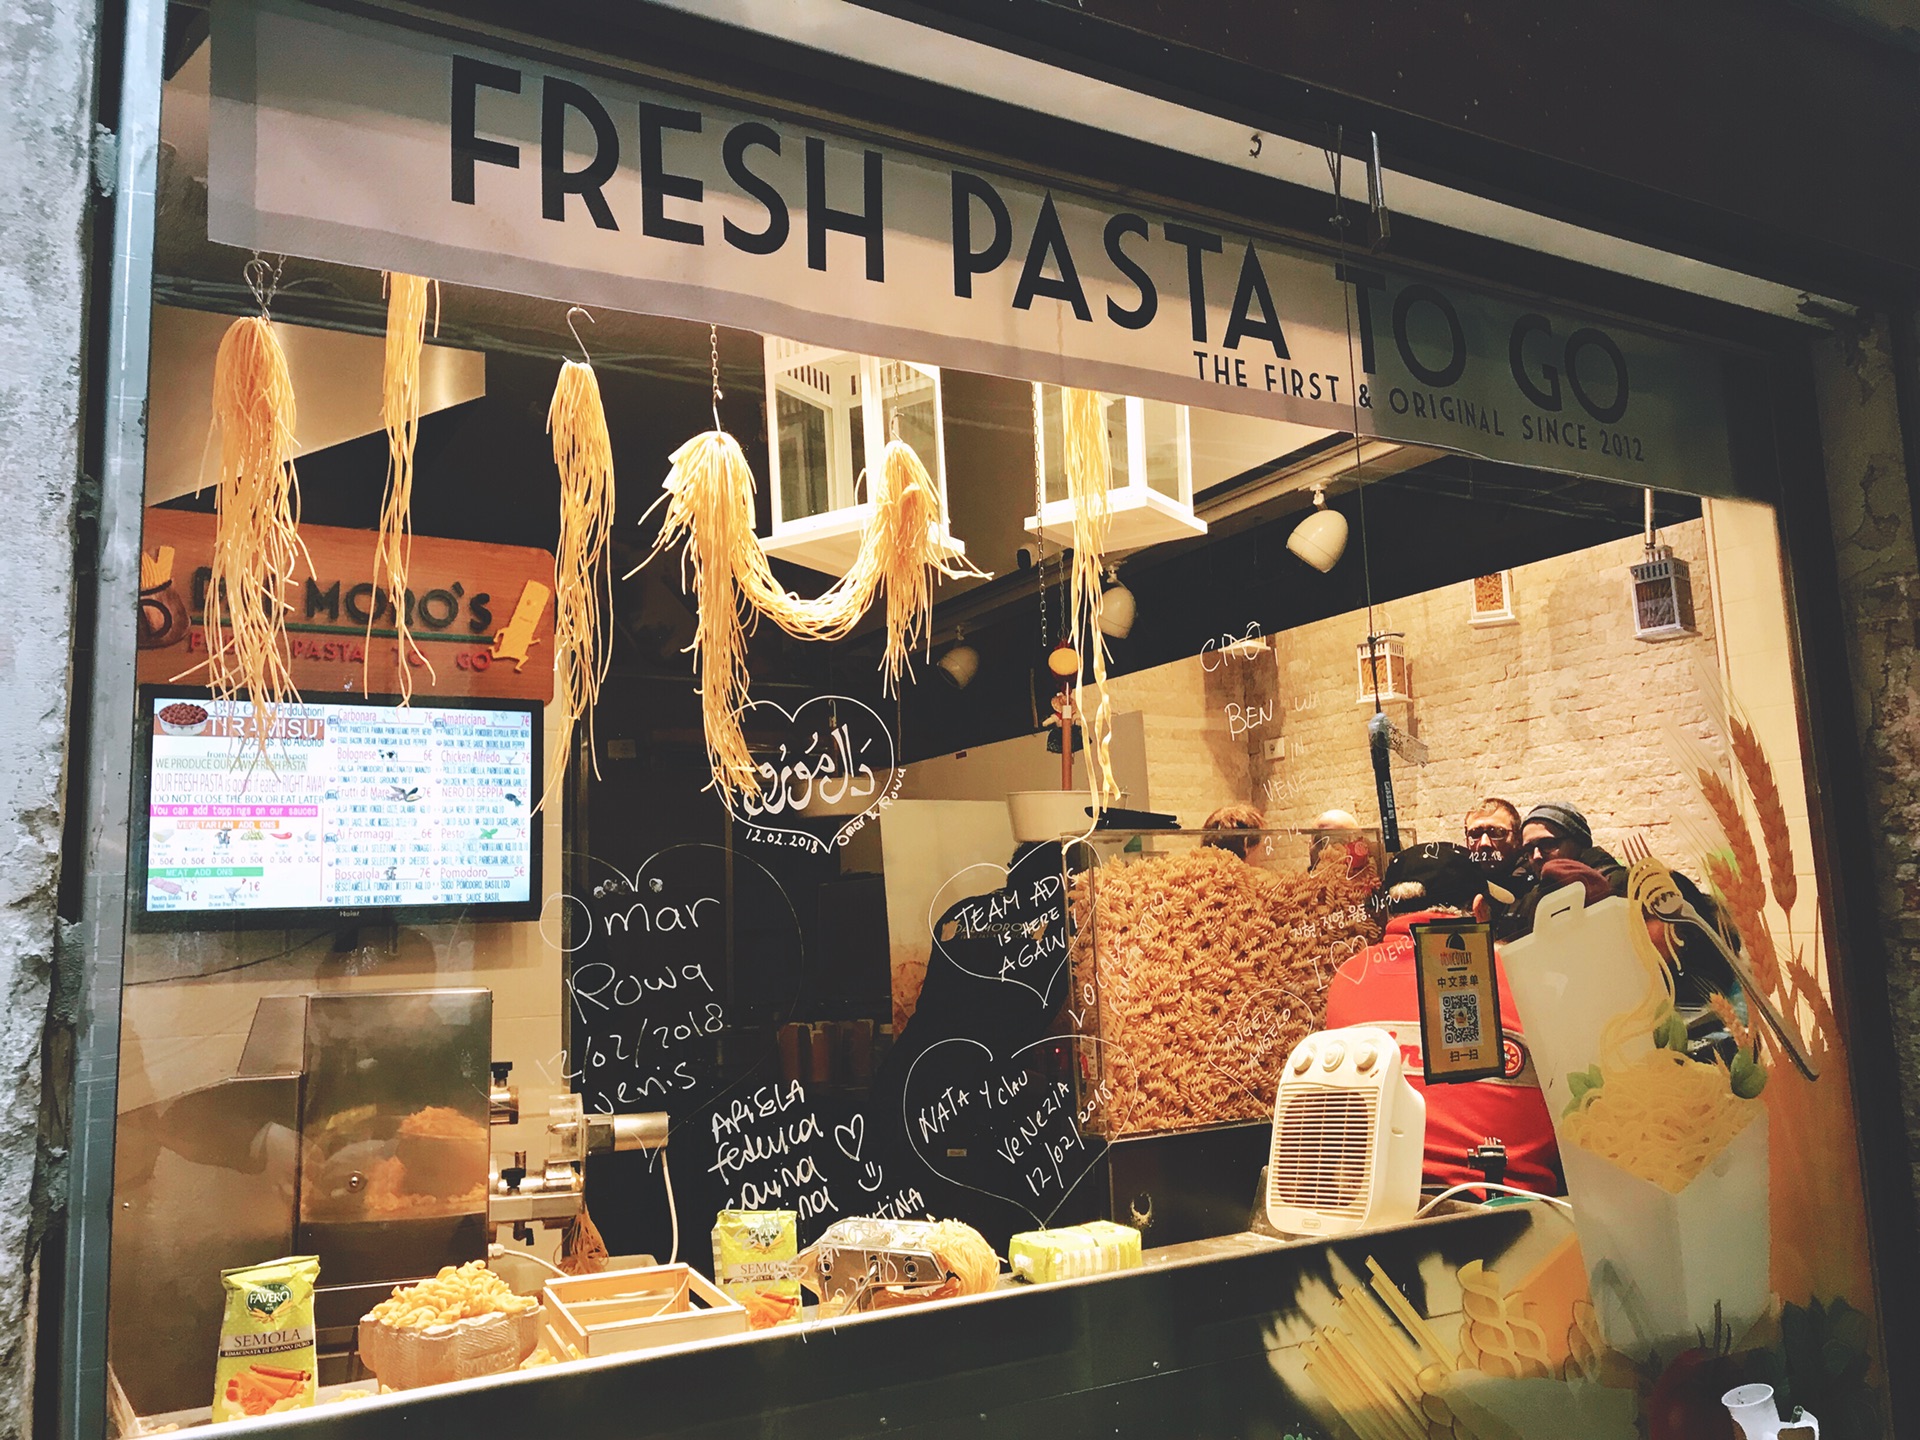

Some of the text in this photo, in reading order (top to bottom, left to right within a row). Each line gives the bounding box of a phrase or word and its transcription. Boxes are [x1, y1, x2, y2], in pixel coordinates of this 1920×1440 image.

[450, 54, 1631, 426] FRESH PASTA TO GO
[1193, 351, 1646, 463] THE FIRST & ORIGINAL SINCE 2012
[290, 638, 365, 664] PASTA
[456, 650, 491, 672] GO
[338, 708, 377, 722] Carbonara
[442, 712, 487, 725] Amatriciana
[1224, 699, 1273, 742] BEN
[337, 747, 377, 763] Bolognese
[441, 749, 471, 762] Chicken
[473, 750, 501, 763] Alfredo
[156, 758, 169, 768] WE
[171, 758, 211, 769] PRODUCE
[213, 758, 232, 769] OUR
[282, 760, 306, 770] PASTA
[156, 774, 172, 791] OUR
[174, 774, 198, 791] FRESH
[200, 774, 222, 791] PASTA
[282, 775, 304, 792] RIGHT
[307, 775, 327, 792] AWAY
[154, 794, 325, 803] DO NOT CLOSE THE BOX OR EAT LATER
[360, 785, 369, 797] di
[370, 786, 390, 798] Mare
[442, 787, 464, 797] NERO
[467, 787, 475, 797] DI
[477, 788, 504, 798] SEPPIA
[153, 805, 317, 817] You can add toppings on our sauces
[177, 821, 276, 829] VEGETARIAN ADD ONS
[836, 815, 866, 848] Omar
[348, 828, 394, 841] Formaggi
[441, 828, 465, 838] Pesto
[745, 828, 819, 855] 12.02.2018
[166, 868, 233, 876] MEAT ADD ONS
[335, 867, 431, 880] Boscaiola 7€
[441, 866, 525, 878] Pomodoro 5€
[954, 889, 1021, 939] TEAM
[539, 893, 720, 952] Omar
[998, 906, 1060, 947] IS HERE
[1437, 974, 1479, 988] 中文菜单
[1449, 1048, 1479, 1063] 扫一扫
[918, 1086, 970, 1144] NATA
[249, 1290, 289, 1304] FAVERO
[234, 1328, 301, 1348] SEMOLA
